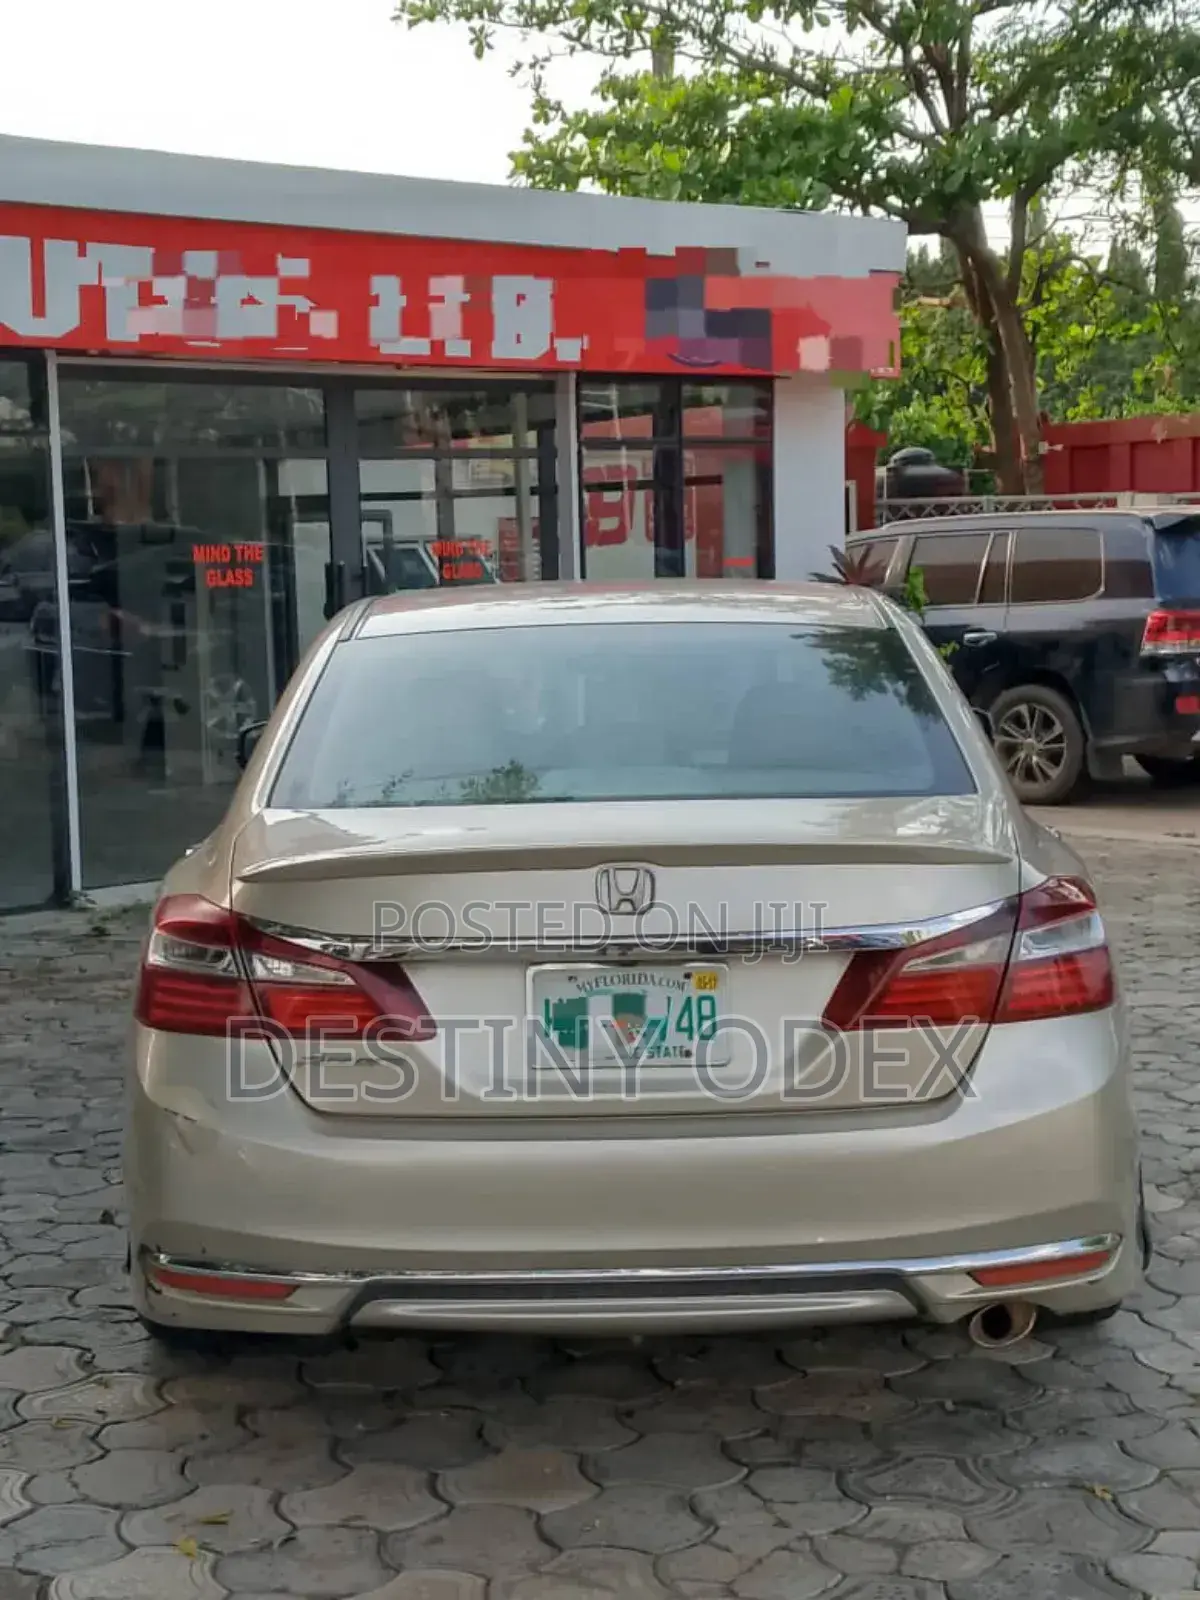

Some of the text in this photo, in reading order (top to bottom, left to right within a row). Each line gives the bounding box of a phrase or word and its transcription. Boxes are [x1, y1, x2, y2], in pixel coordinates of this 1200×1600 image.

[192, 544, 264, 563] MIND THE
[206, 567, 254, 588] GLASS
[576, 971, 688, 993] MYFLORIDA.COM
